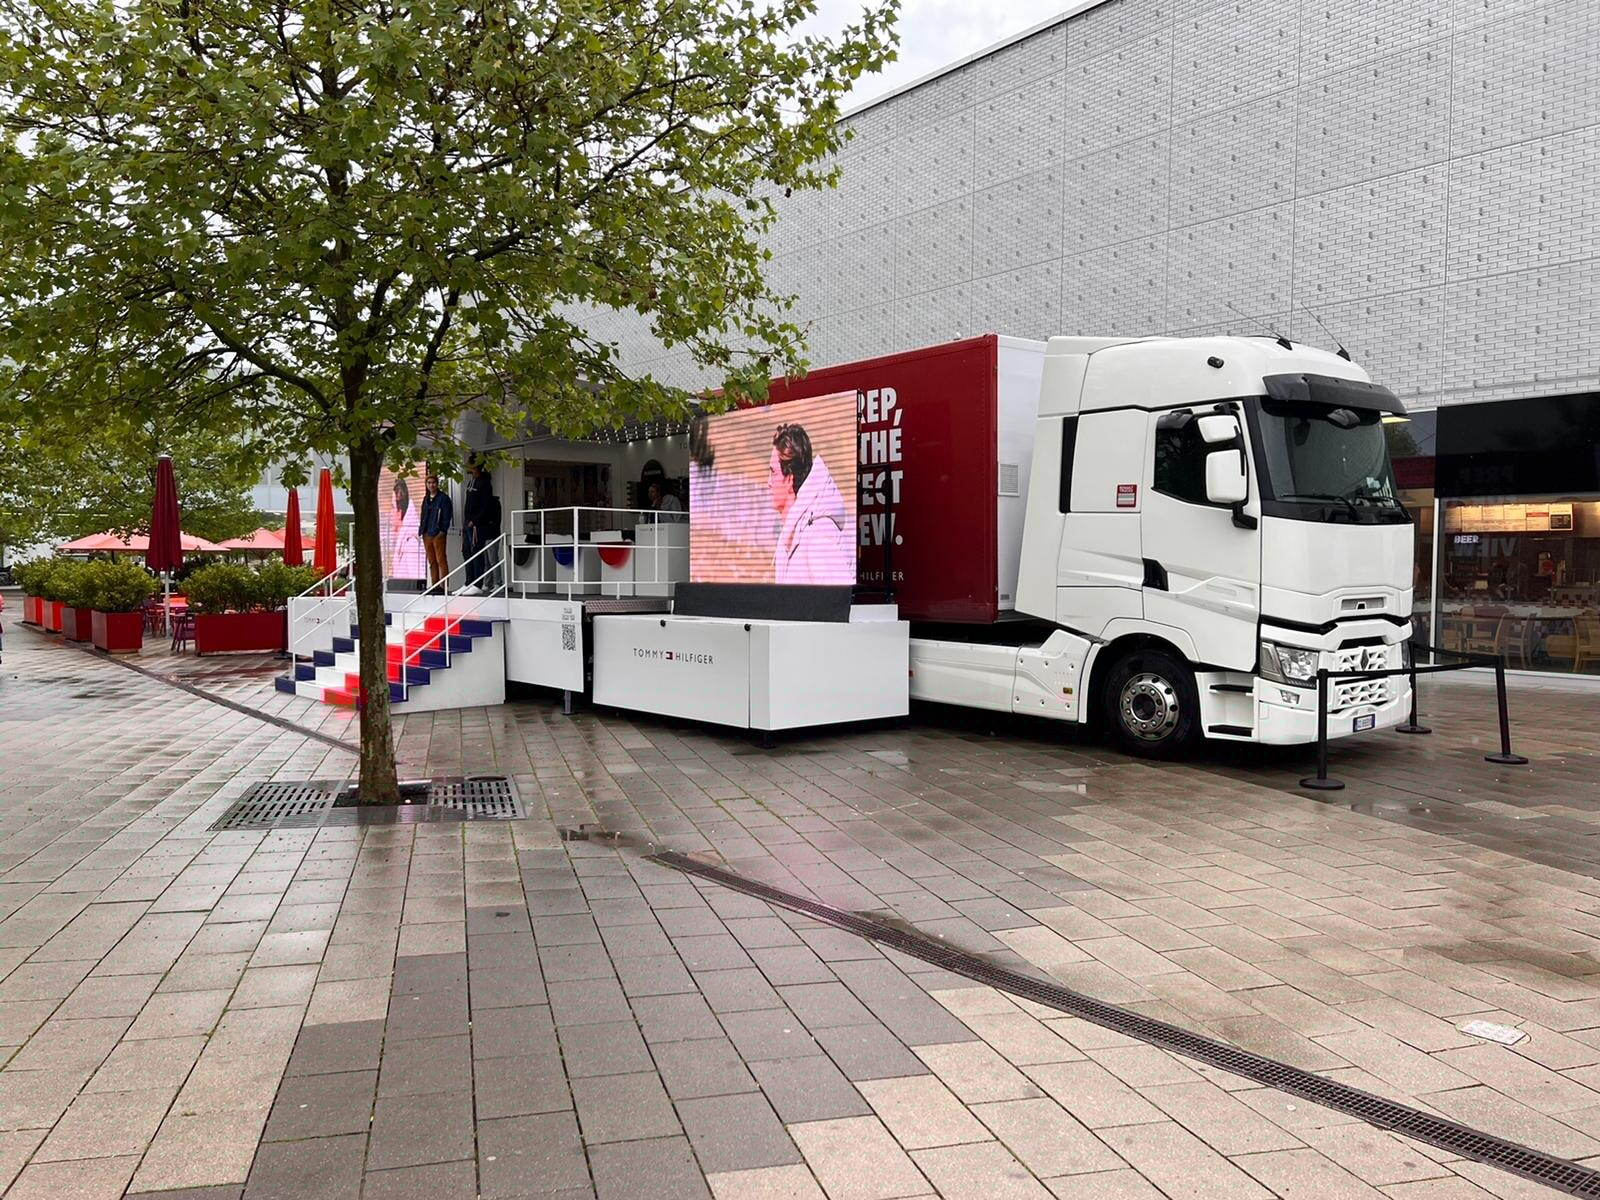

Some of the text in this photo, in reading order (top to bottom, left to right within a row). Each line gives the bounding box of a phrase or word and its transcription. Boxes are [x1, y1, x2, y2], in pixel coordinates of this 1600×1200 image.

[860, 428, 902, 464] THE
[857, 470, 903, 505] ECT
[1454, 534, 1479, 544] BEER
[860, 571, 904, 582] HILFIER
[633, 648, 713, 664] TOMMY HILFIGER
